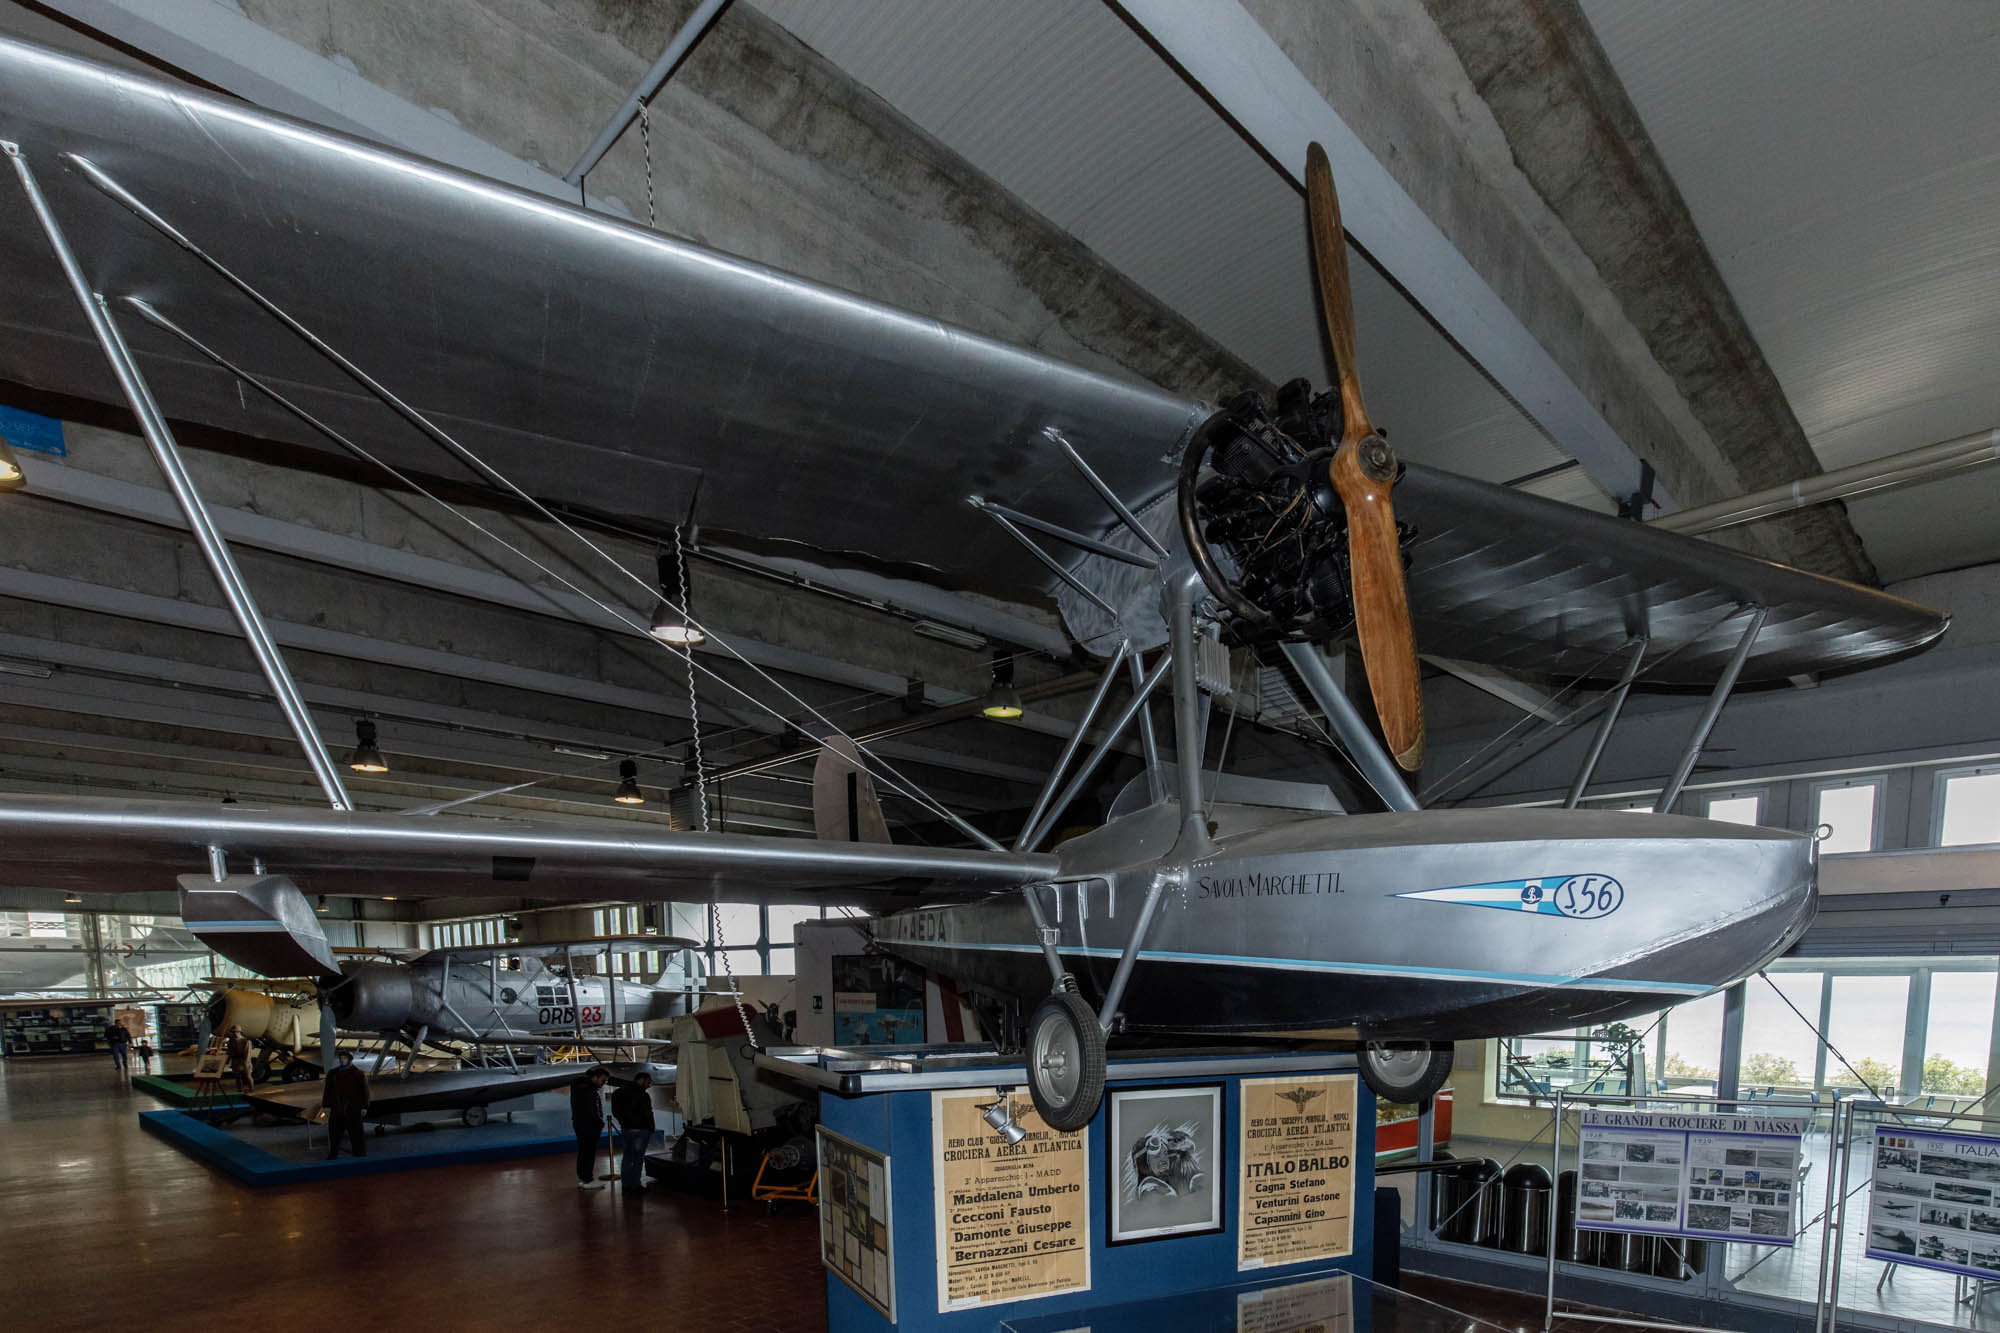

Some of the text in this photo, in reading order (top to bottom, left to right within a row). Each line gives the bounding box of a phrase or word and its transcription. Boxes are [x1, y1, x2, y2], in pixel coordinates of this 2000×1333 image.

[1564, 878, 1613, 915] S.56
[581, 1005, 602, 1024] 23
[1247, 1122, 1351, 1139] CROCIERA AEREA ATLANTICA
[1584, 1112, 1800, 1135] LE GRANDI CROCIERE DI MASSA
[944, 1140, 1082, 1162] CROCIERA AEREA ATLANTICA
[948, 1137, 965, 1148] AERO
[967, 1136, 984, 1147] CLUB
[1036, 1168, 1062, 1178] MADD
[1246, 1155, 1350, 1178] ITALO BALBO
[953, 1190, 1023, 1206] Maddalena
[1028, 1184, 1080, 1197] Umberto
[1255, 1182, 1286, 1194] Cagna
[1290, 1178, 1326, 1189] Stefano
[1256, 1195, 1300, 1209] Venturini
[1303, 1192, 1341, 1203] Gastone
[952, 1204, 1052, 1224] Cecconi Fausto
[1254, 1211, 1301, 1226] Capannini
[1305, 1209, 1326, 1219] Gino
[954, 1226, 1011, 1243] Damonte
[1017, 1220, 1072, 1235] Giuseppe
[955, 1243, 1028, 1262] Bernazzani
[1033, 1237, 1077, 1251] Cesare
